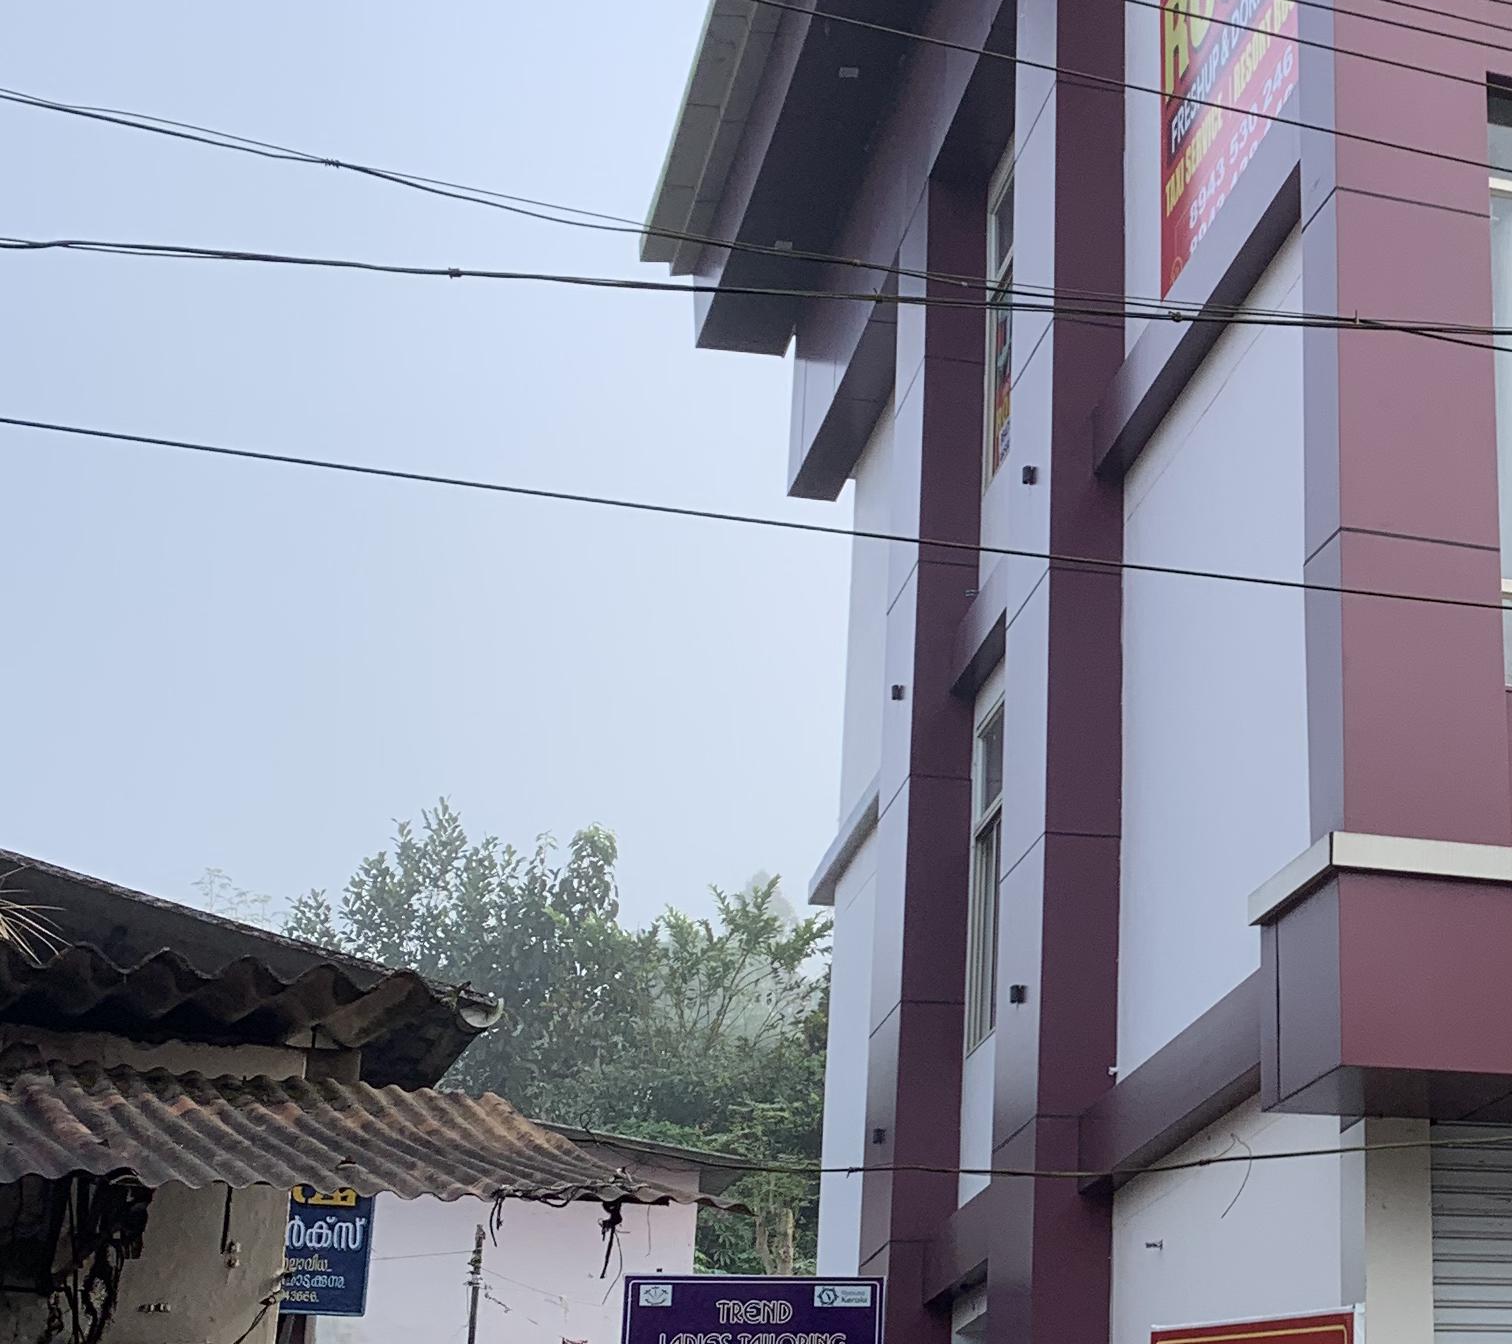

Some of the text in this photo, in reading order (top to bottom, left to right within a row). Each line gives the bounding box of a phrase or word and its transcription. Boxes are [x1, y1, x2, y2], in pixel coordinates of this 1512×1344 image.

[1171, 48, 1220, 153] FRESHUP
[1166, 157, 1184, 218] TAXI
[1185, 90, 1223, 184] SERVICE
[716, 1300, 793, 1324] TREND
